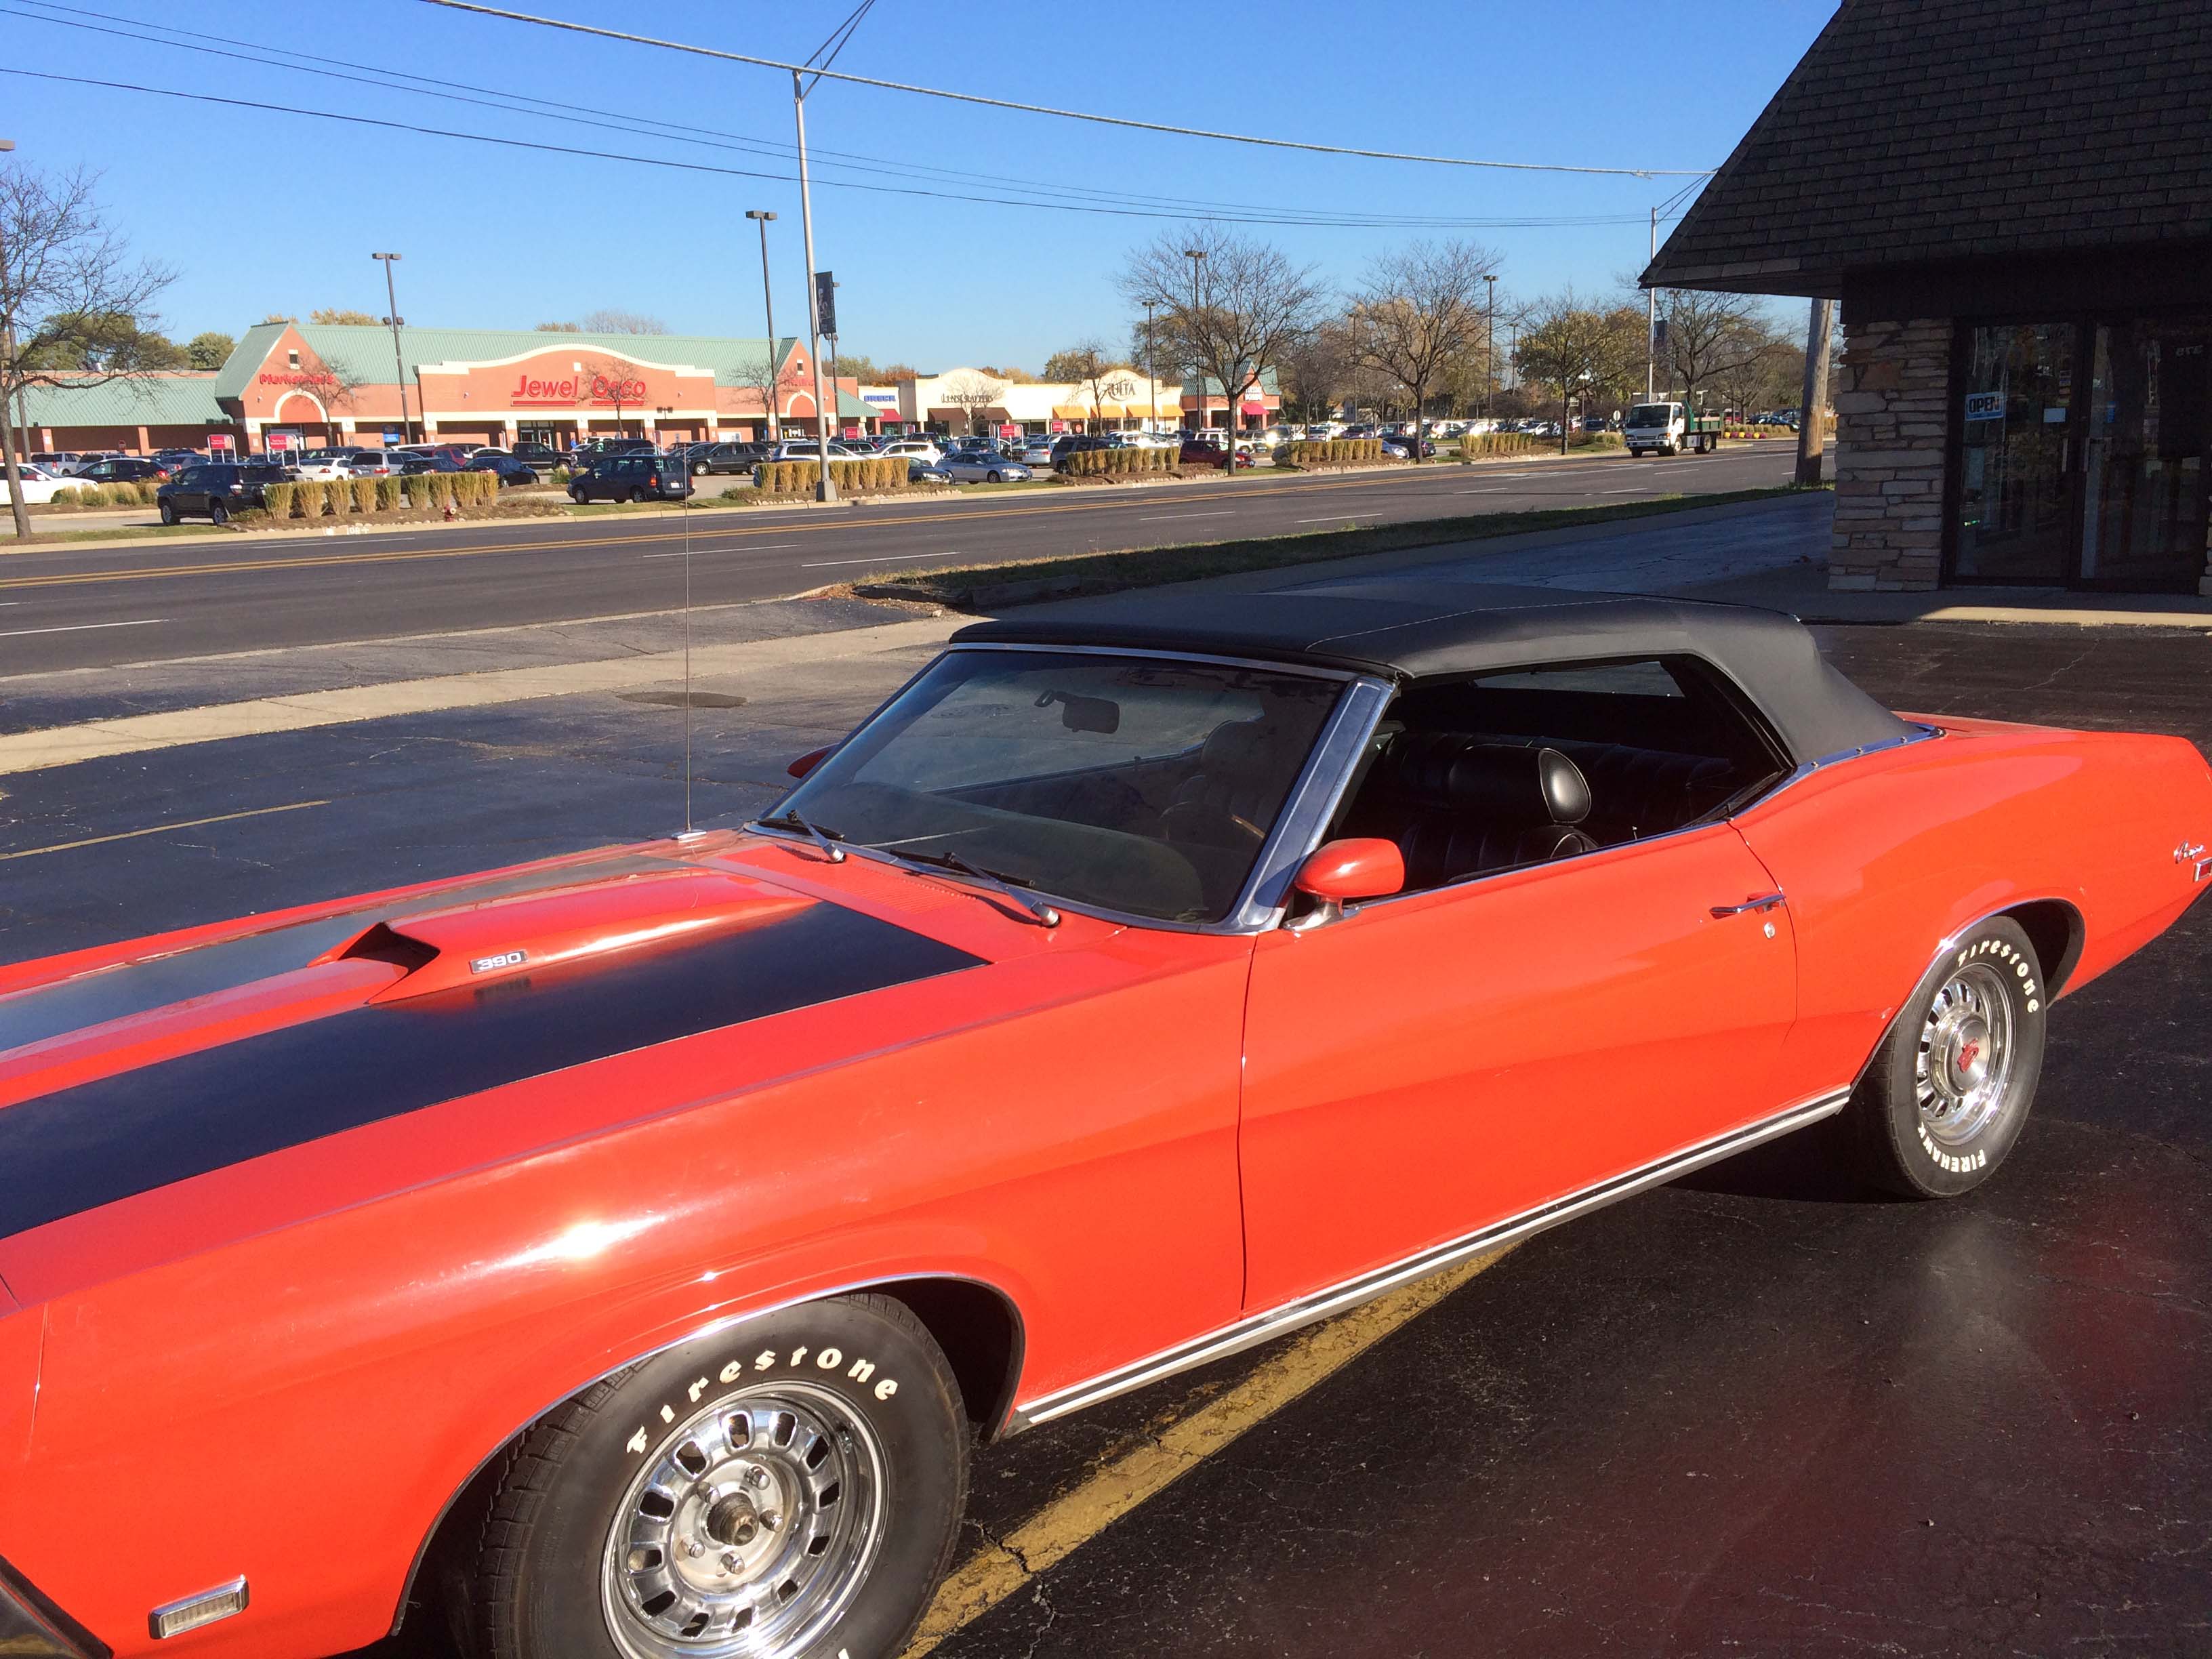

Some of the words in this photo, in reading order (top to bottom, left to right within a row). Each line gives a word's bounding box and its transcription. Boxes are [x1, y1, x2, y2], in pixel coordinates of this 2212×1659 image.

[511, 375, 579, 398] Jewel
[592, 375, 647, 397] Osco
[1110, 382, 1136, 396] ULTA
[1968, 396, 2001, 413] OPEN
[476, 951, 522, 970] 390
[1957, 940, 2039, 1013] Firestone
[1917, 1122, 1986, 1172] FIREHAWK
[626, 1345, 899, 1454] Firestone
